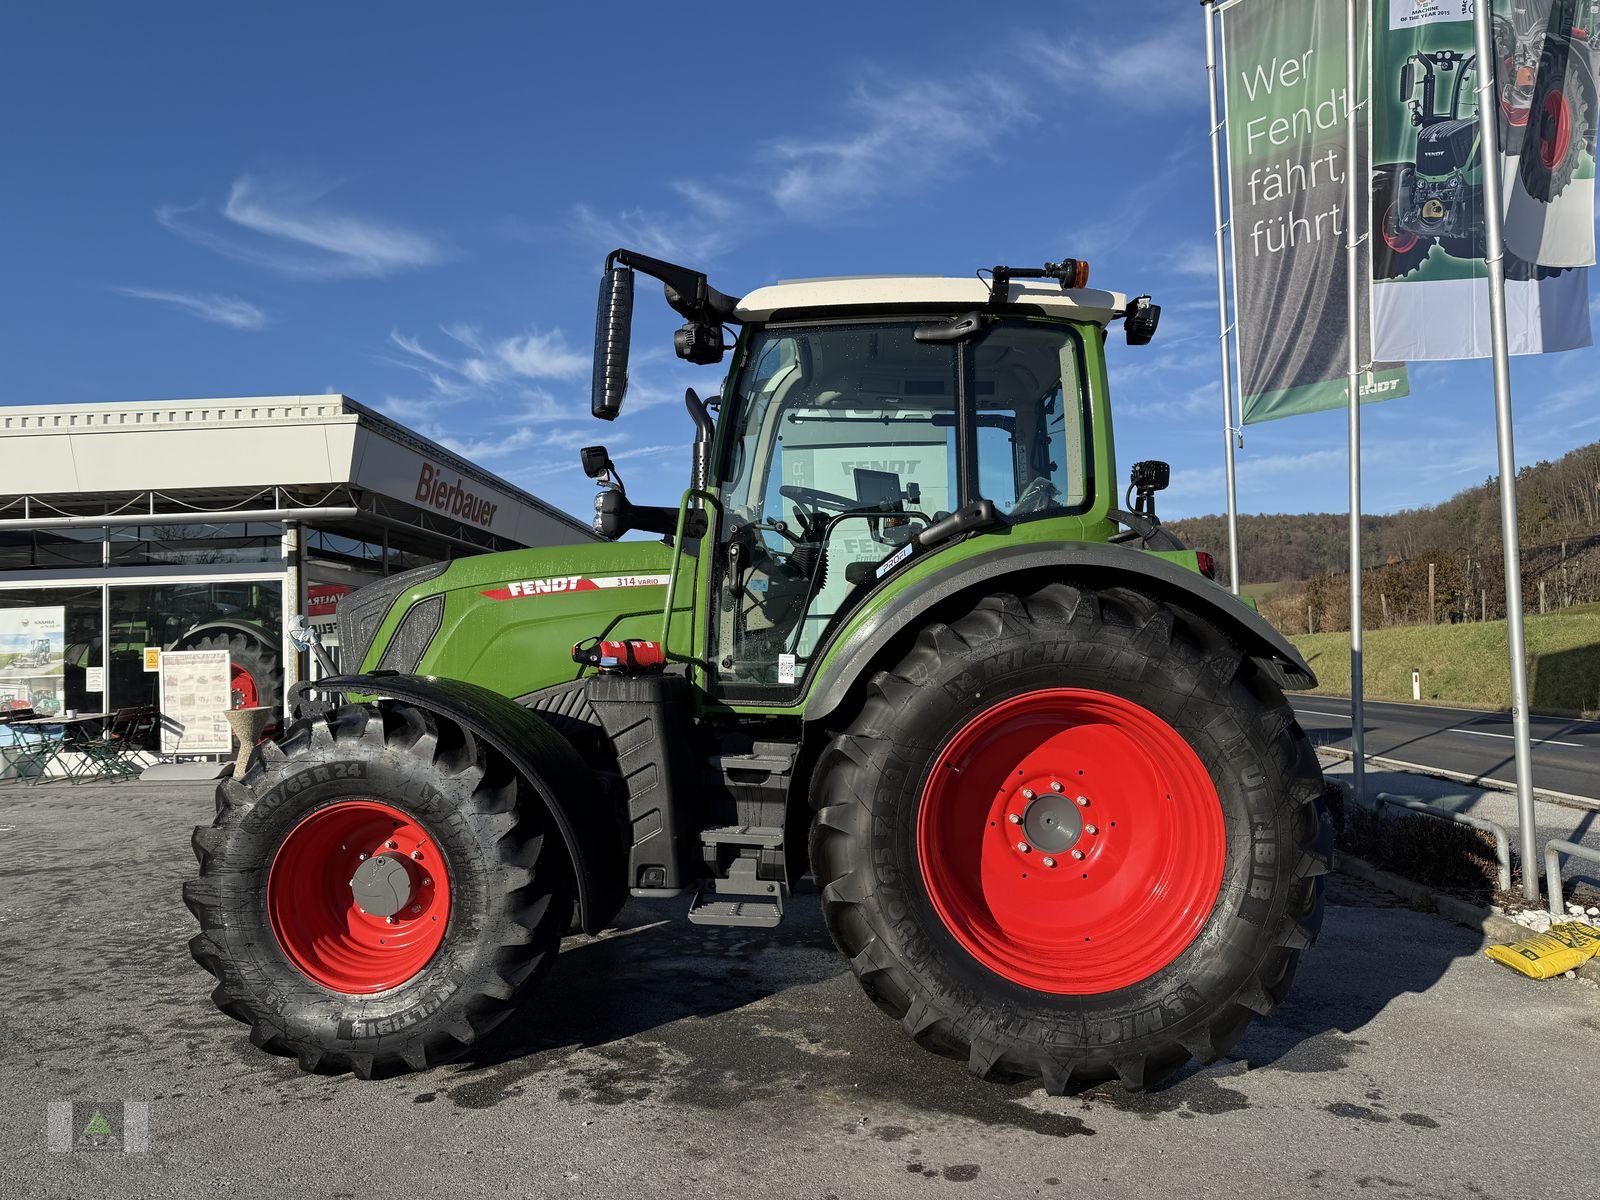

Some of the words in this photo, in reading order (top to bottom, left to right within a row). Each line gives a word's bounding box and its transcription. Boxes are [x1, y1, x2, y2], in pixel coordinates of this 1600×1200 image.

[1411, 5, 1440, 16] MACHINE
[1421, 11, 1437, 19] YEAR
[1241, 49, 1314, 102] Wer
[1246, 88, 1347, 155] Fendt
[1247, 149, 1345, 206] fährt,
[1250, 203, 1347, 257] führt
[1344, 378, 1400, 399] ENDT
[415, 461, 499, 528] Bierbauer
[844, 538, 891, 554] FEN
[507, 575, 583, 597] FENDT
[616, 577, 636, 587] 314
[637, 578, 660, 586] VARIO
[313, 767, 332, 783] R
[334, 763, 362, 779] 24
